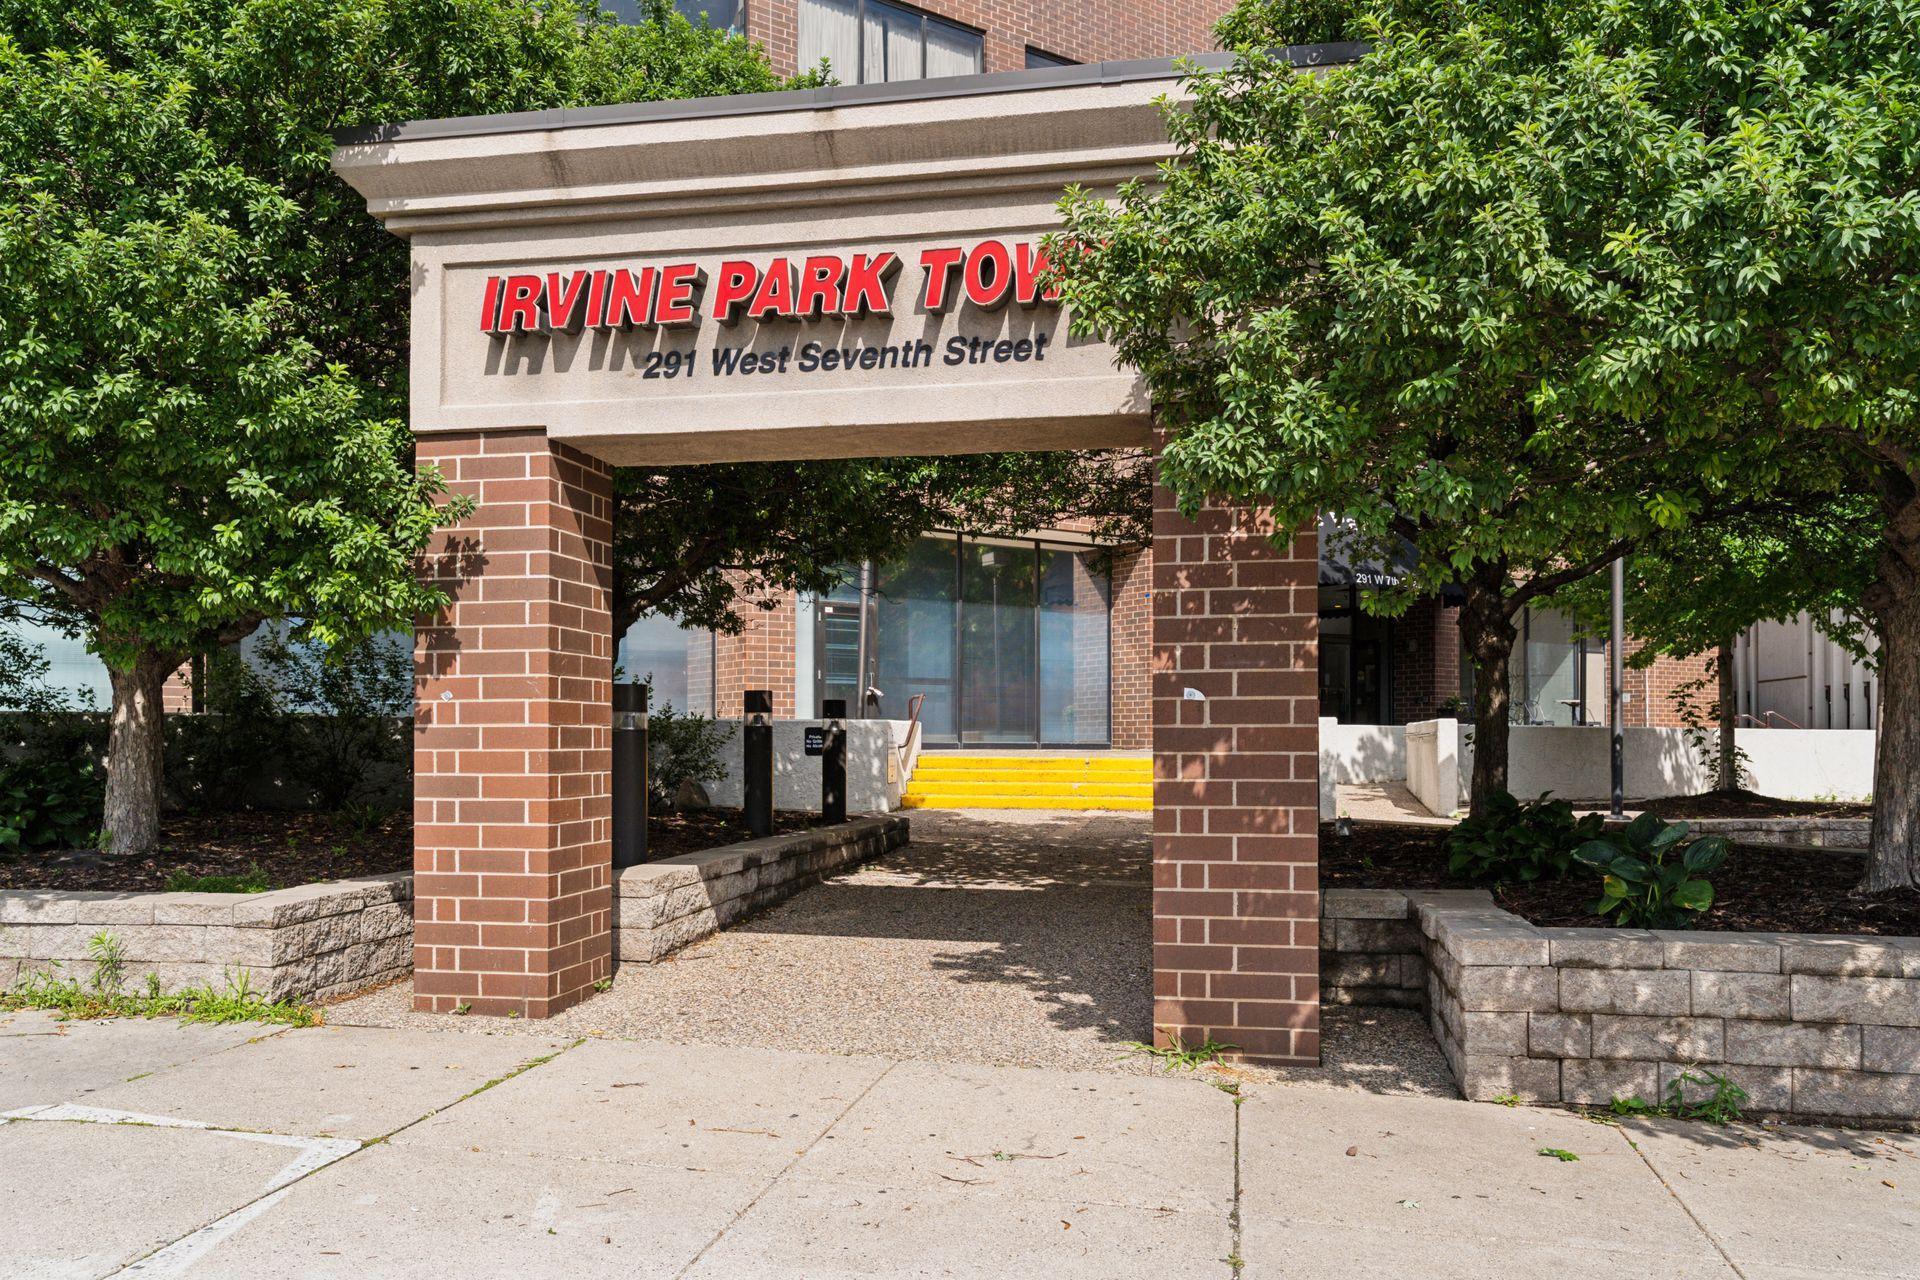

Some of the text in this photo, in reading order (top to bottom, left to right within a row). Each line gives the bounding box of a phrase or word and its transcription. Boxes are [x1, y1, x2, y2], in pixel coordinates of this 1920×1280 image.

[480, 242, 1090, 333] IRVINE PARK TOW
[643, 332, 1048, 379] 291 West Seventh Street
[1356, 573, 1372, 584] 291
[1374, 574, 1384, 585] W
[1385, 575, 1400, 586] 7th
